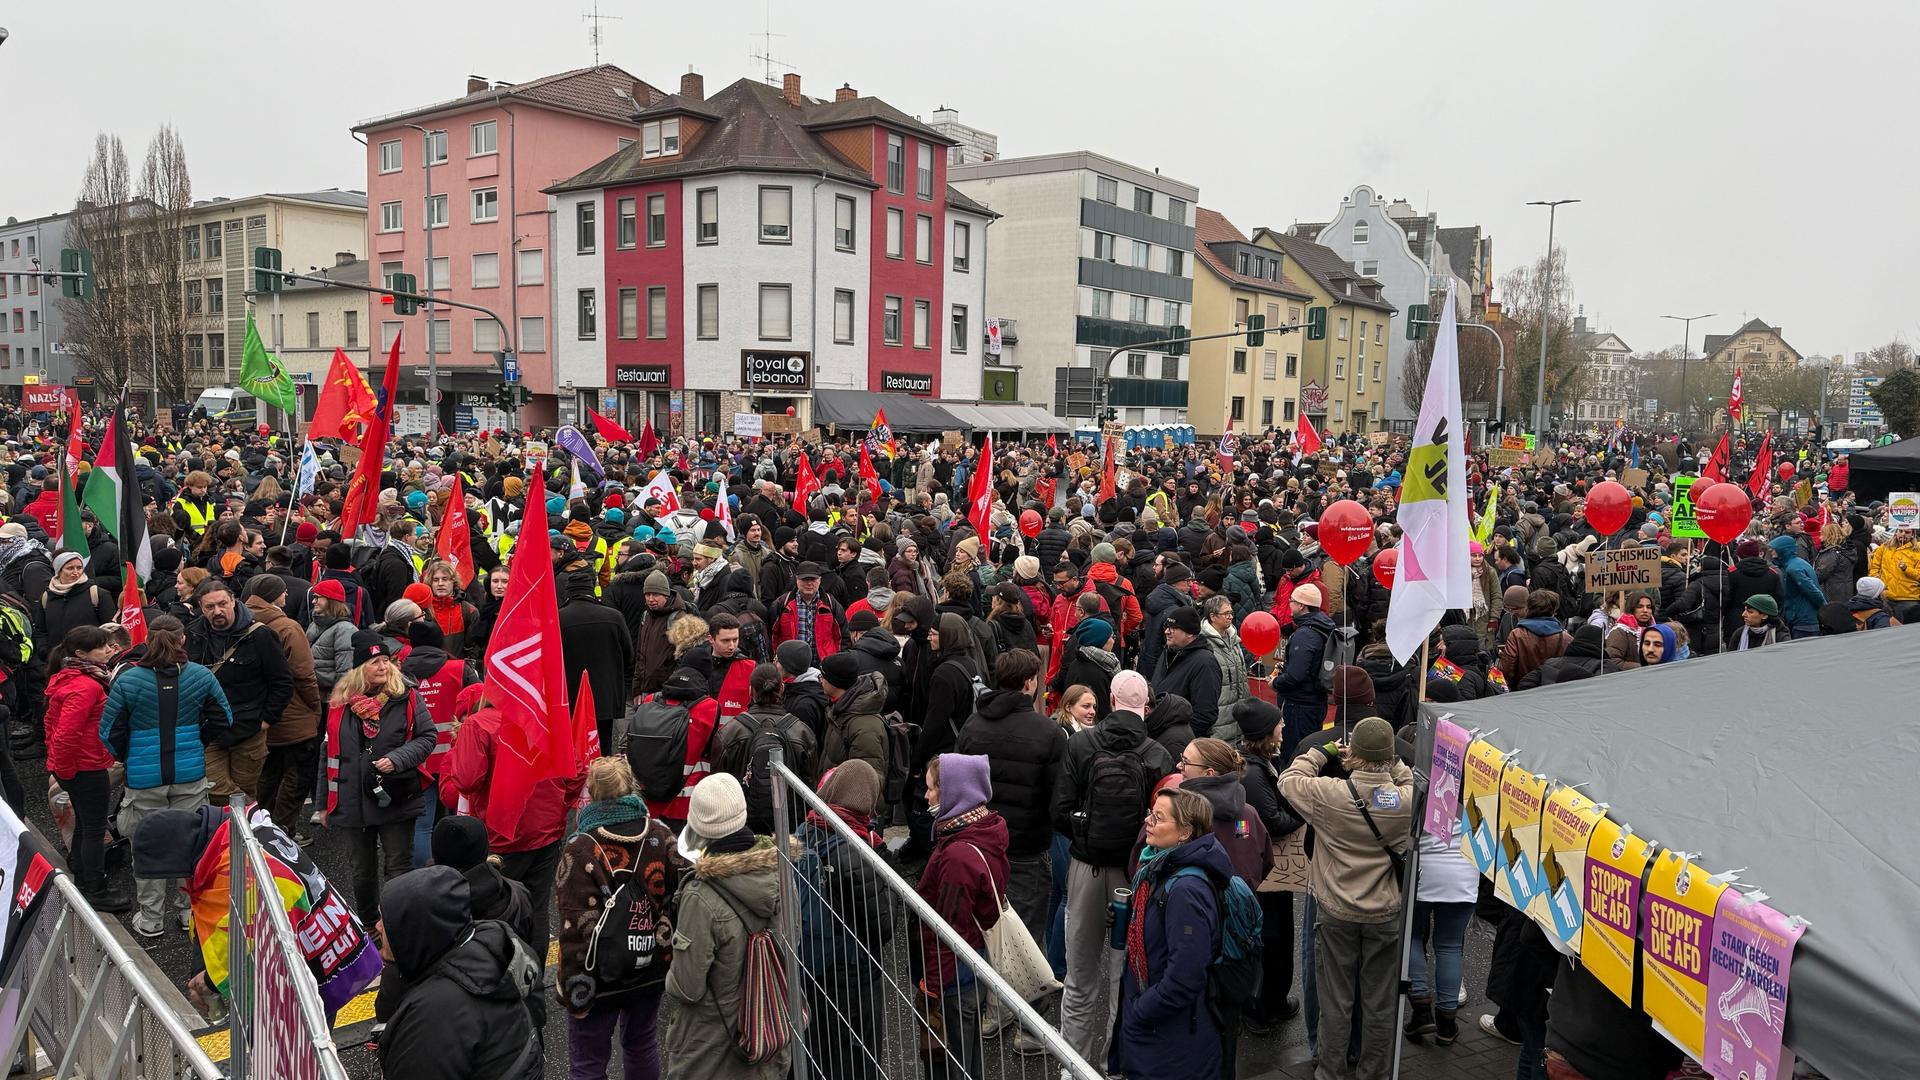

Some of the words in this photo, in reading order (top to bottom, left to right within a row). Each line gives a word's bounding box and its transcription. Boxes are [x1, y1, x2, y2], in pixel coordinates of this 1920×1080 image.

[617, 369, 666, 382] Restaurant
[746, 371, 804, 384] Lebanon
[886, 376, 931, 390] Restaurant
[29, 392, 59, 404] NAZIS
[1590, 549, 1659, 564] FSCHISMUS
[1592, 570, 1649, 587] MEINUNG
[1467, 753, 1476, 767] NIE
[1475, 757, 1492, 777] WIEDER
[1502, 781, 1512, 796] NIE
[1511, 785, 1531, 807] WIEDER
[1547, 800, 1559, 816] NIE
[1557, 806, 1580, 831] WIEDER
[1591, 865, 1632, 904] STOPPT
[1591, 888, 1608, 919] DIE
[1609, 898, 1631, 930] AFD
[1651, 901, 1702, 946] STOPPT
[320, 926, 360, 970] auf
[1651, 927, 1672, 961] DIE
[1674, 939, 1701, 974] AFD
[1721, 931, 1747, 959] STARK
[1749, 946, 1779, 976] GEGEN
[1712, 947, 1744, 978] RECHTE
[1745, 966, 1786, 1003] PAROLEN
